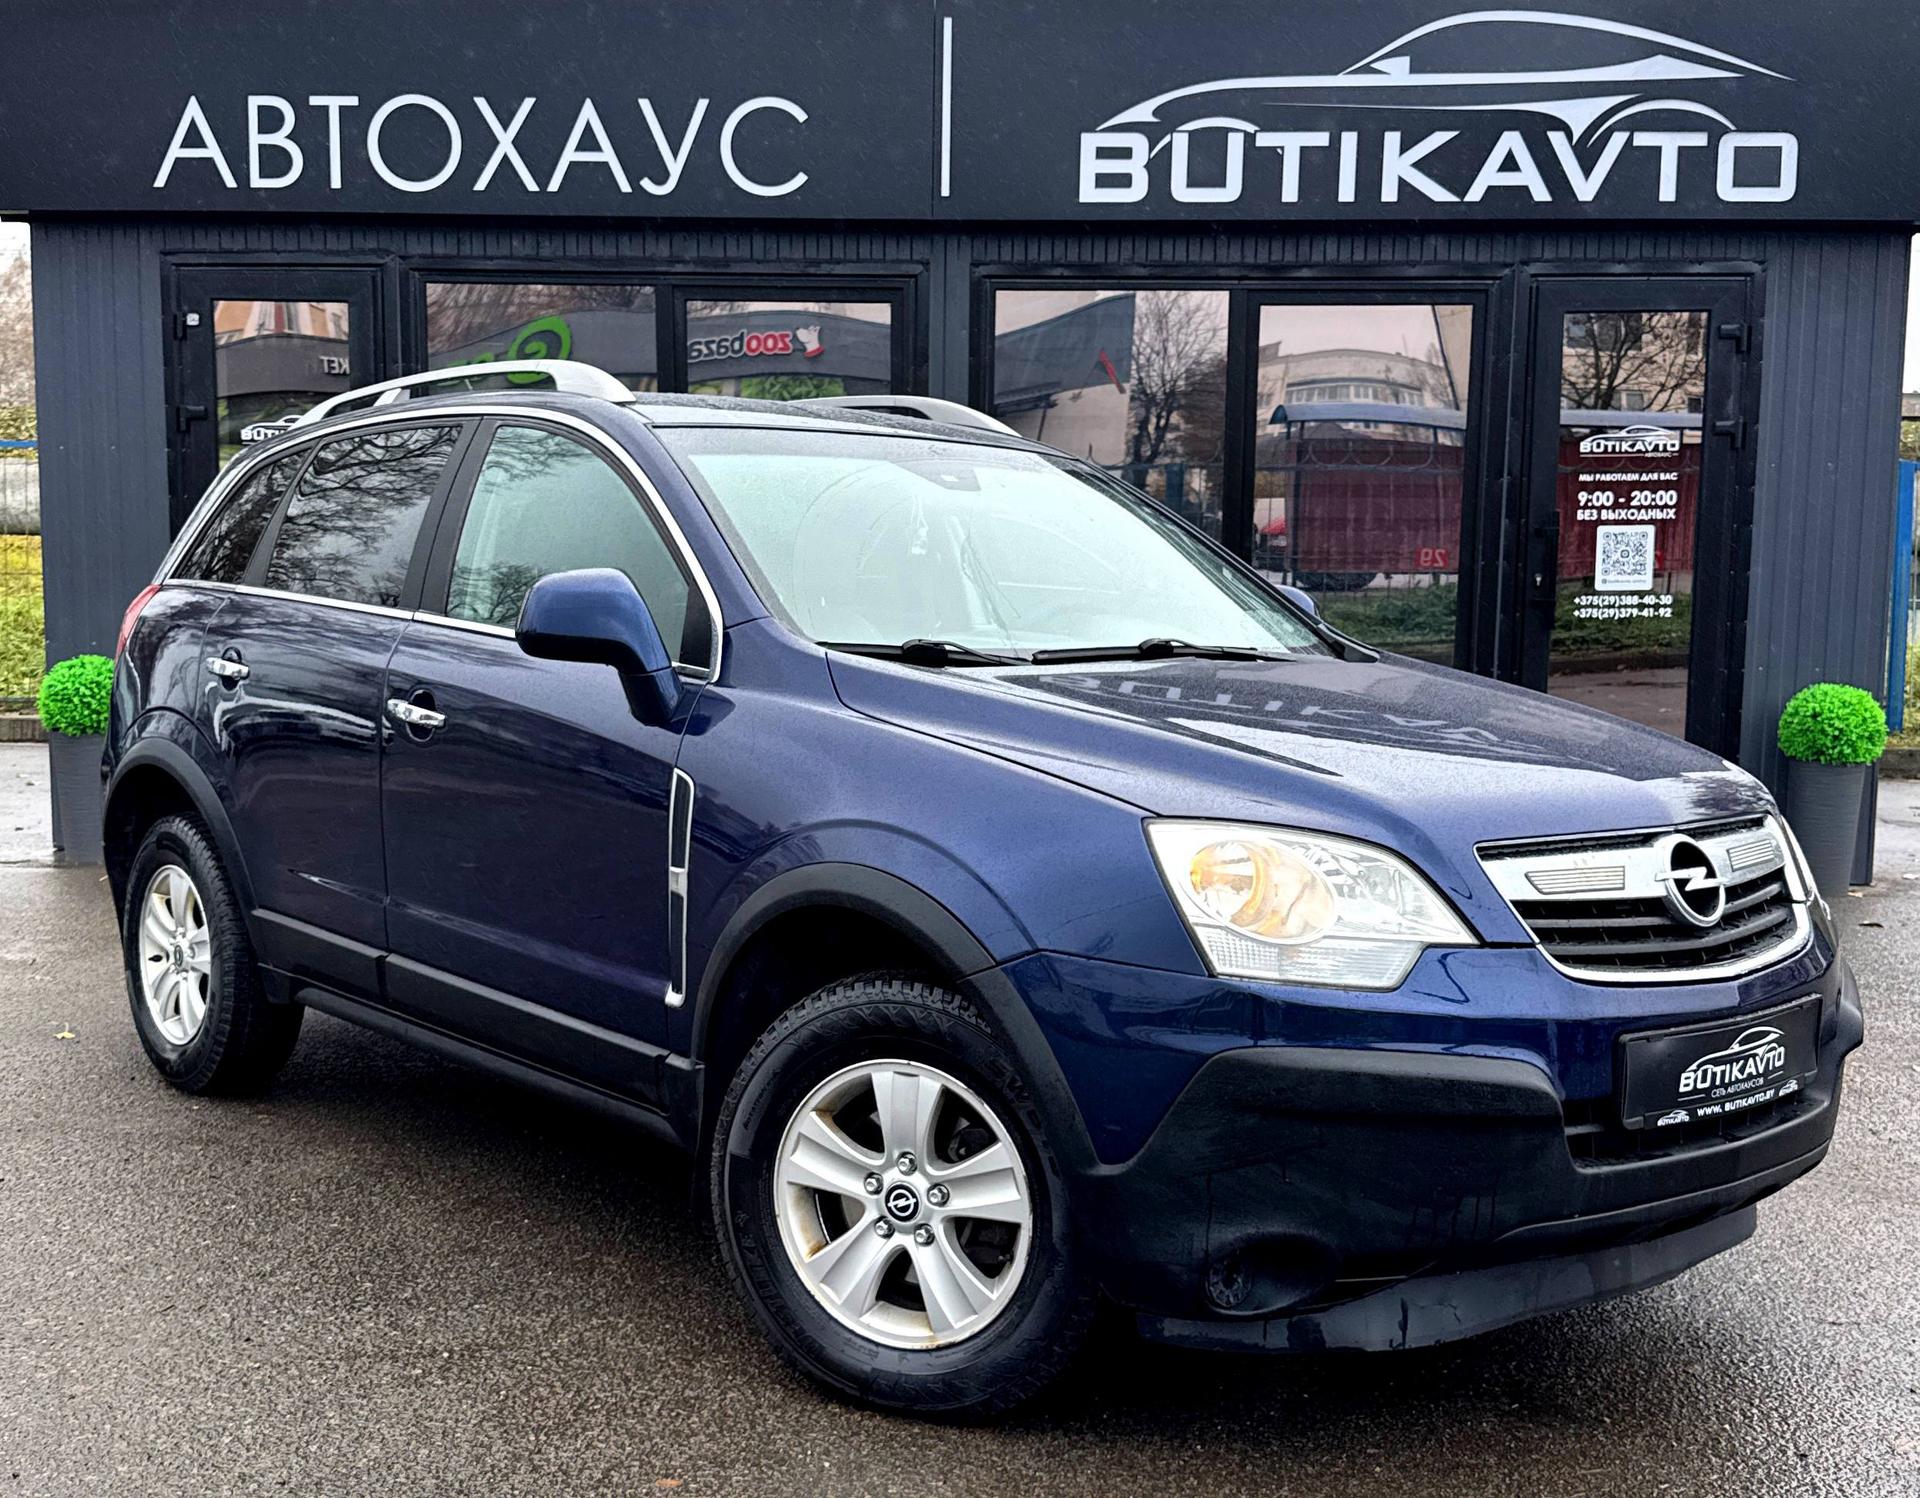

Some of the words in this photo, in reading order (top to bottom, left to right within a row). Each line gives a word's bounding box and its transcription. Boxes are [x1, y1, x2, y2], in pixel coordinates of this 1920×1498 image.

[154, 93, 809, 197] АВТОХАУС
[1079, 130, 1798, 204] BUTIKAVTO
[1580, 440, 1680, 453] BUTIKAVTO
[1579, 474, 1594, 482] МЫ
[1595, 473, 1639, 482] РАБОТАЕМ
[1640, 473, 1658, 482] ДЛЯ
[1660, 472, 1678, 481] ВАС
[1578, 491, 1614, 506] 9:00
[1630, 490, 1678, 506] 20:00
[1577, 509, 1598, 520] БЕЗ
[1600, 508, 1676, 520] ВЫХОДНЫХ
[1678, 1046, 1786, 1093] BUTIKAVTO
[1697, 1104, 1723, 1117] WWW.
